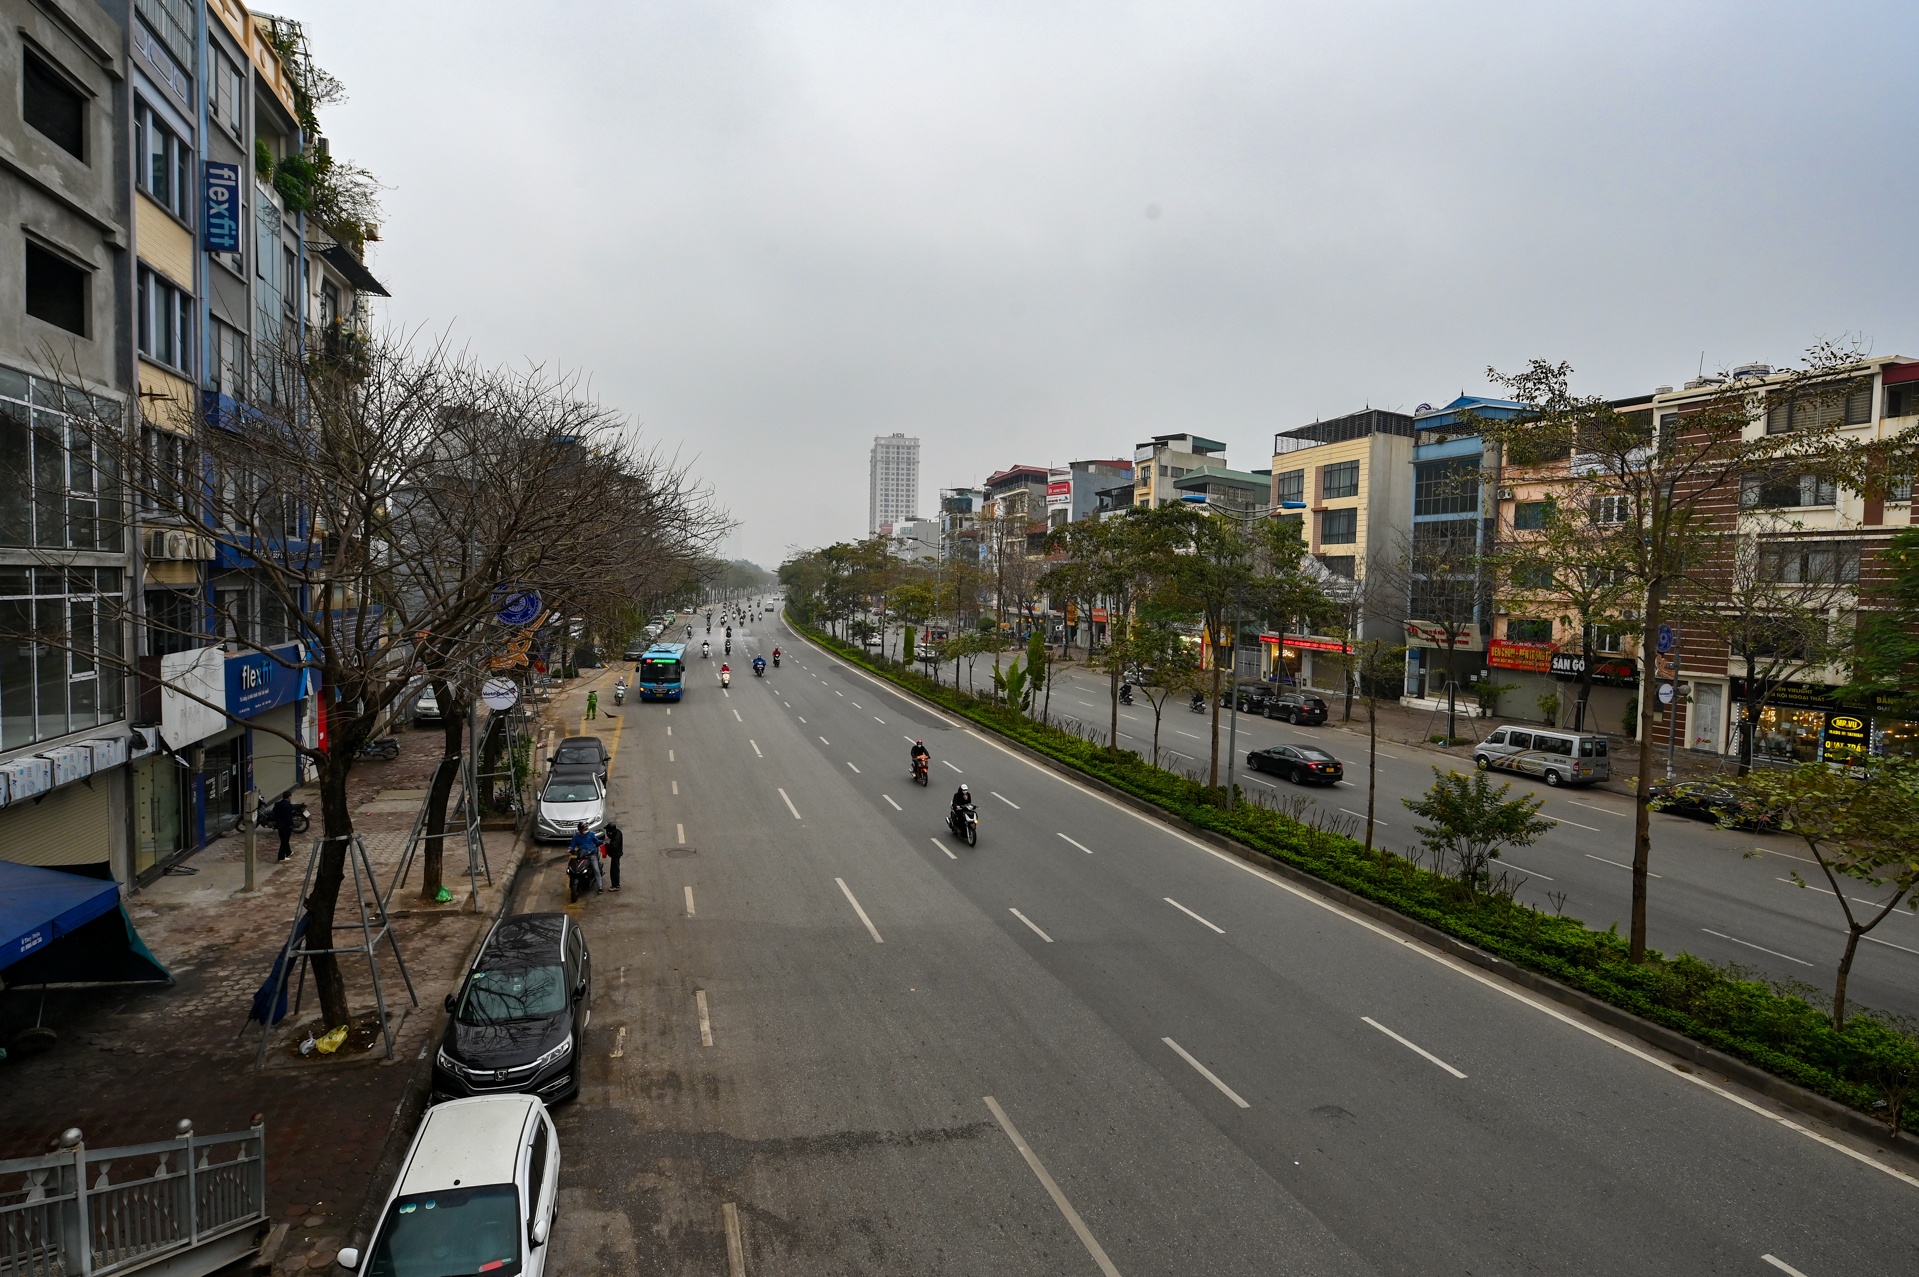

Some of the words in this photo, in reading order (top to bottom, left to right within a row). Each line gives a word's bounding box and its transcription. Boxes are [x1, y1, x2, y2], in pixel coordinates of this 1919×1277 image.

[208, 168, 237, 247] flexfit
[242, 660, 273, 690] flexfit
[1552, 655, 1571, 671] SÀN
